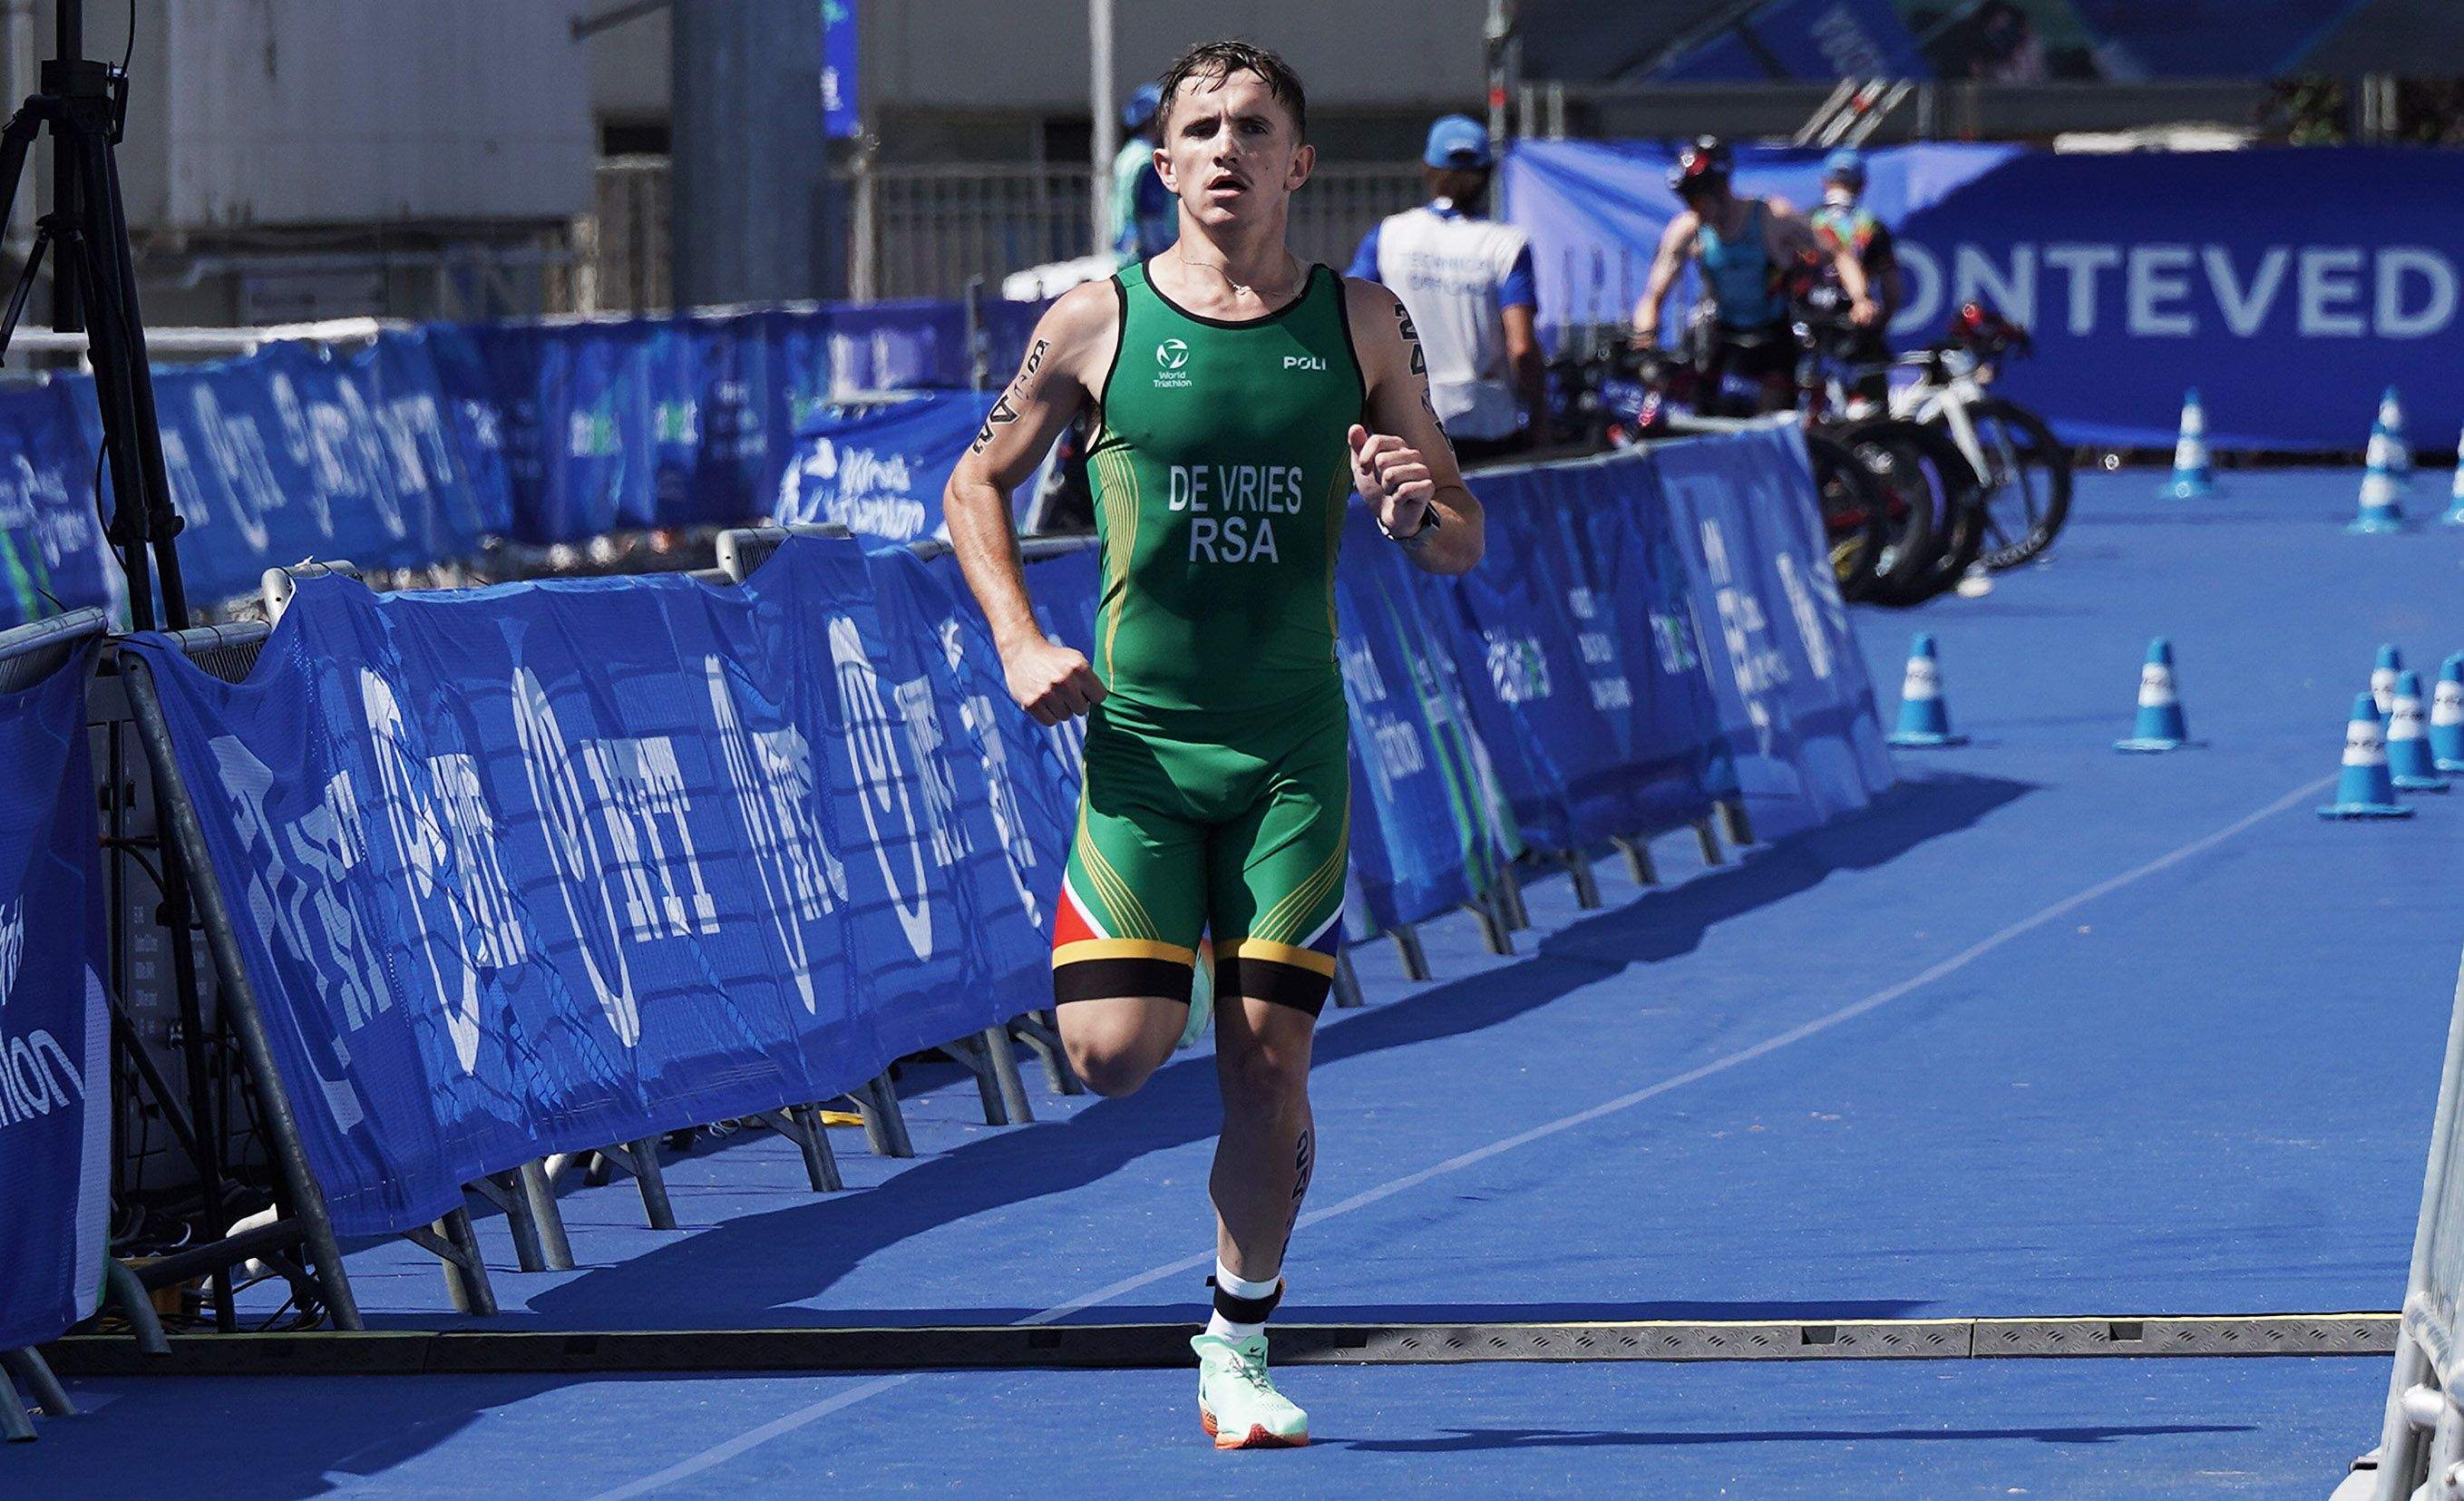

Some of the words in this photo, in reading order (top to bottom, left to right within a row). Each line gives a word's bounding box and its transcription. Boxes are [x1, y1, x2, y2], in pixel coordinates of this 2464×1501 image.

[1282, 356, 1327, 371] POLI
[1153, 378, 1193, 388] Triathlon
[1158, 371, 1186, 380] World
[1168, 464, 1209, 512] DE
[1219, 464, 1303, 515] VRIES
[1188, 515, 1280, 563] RSA
